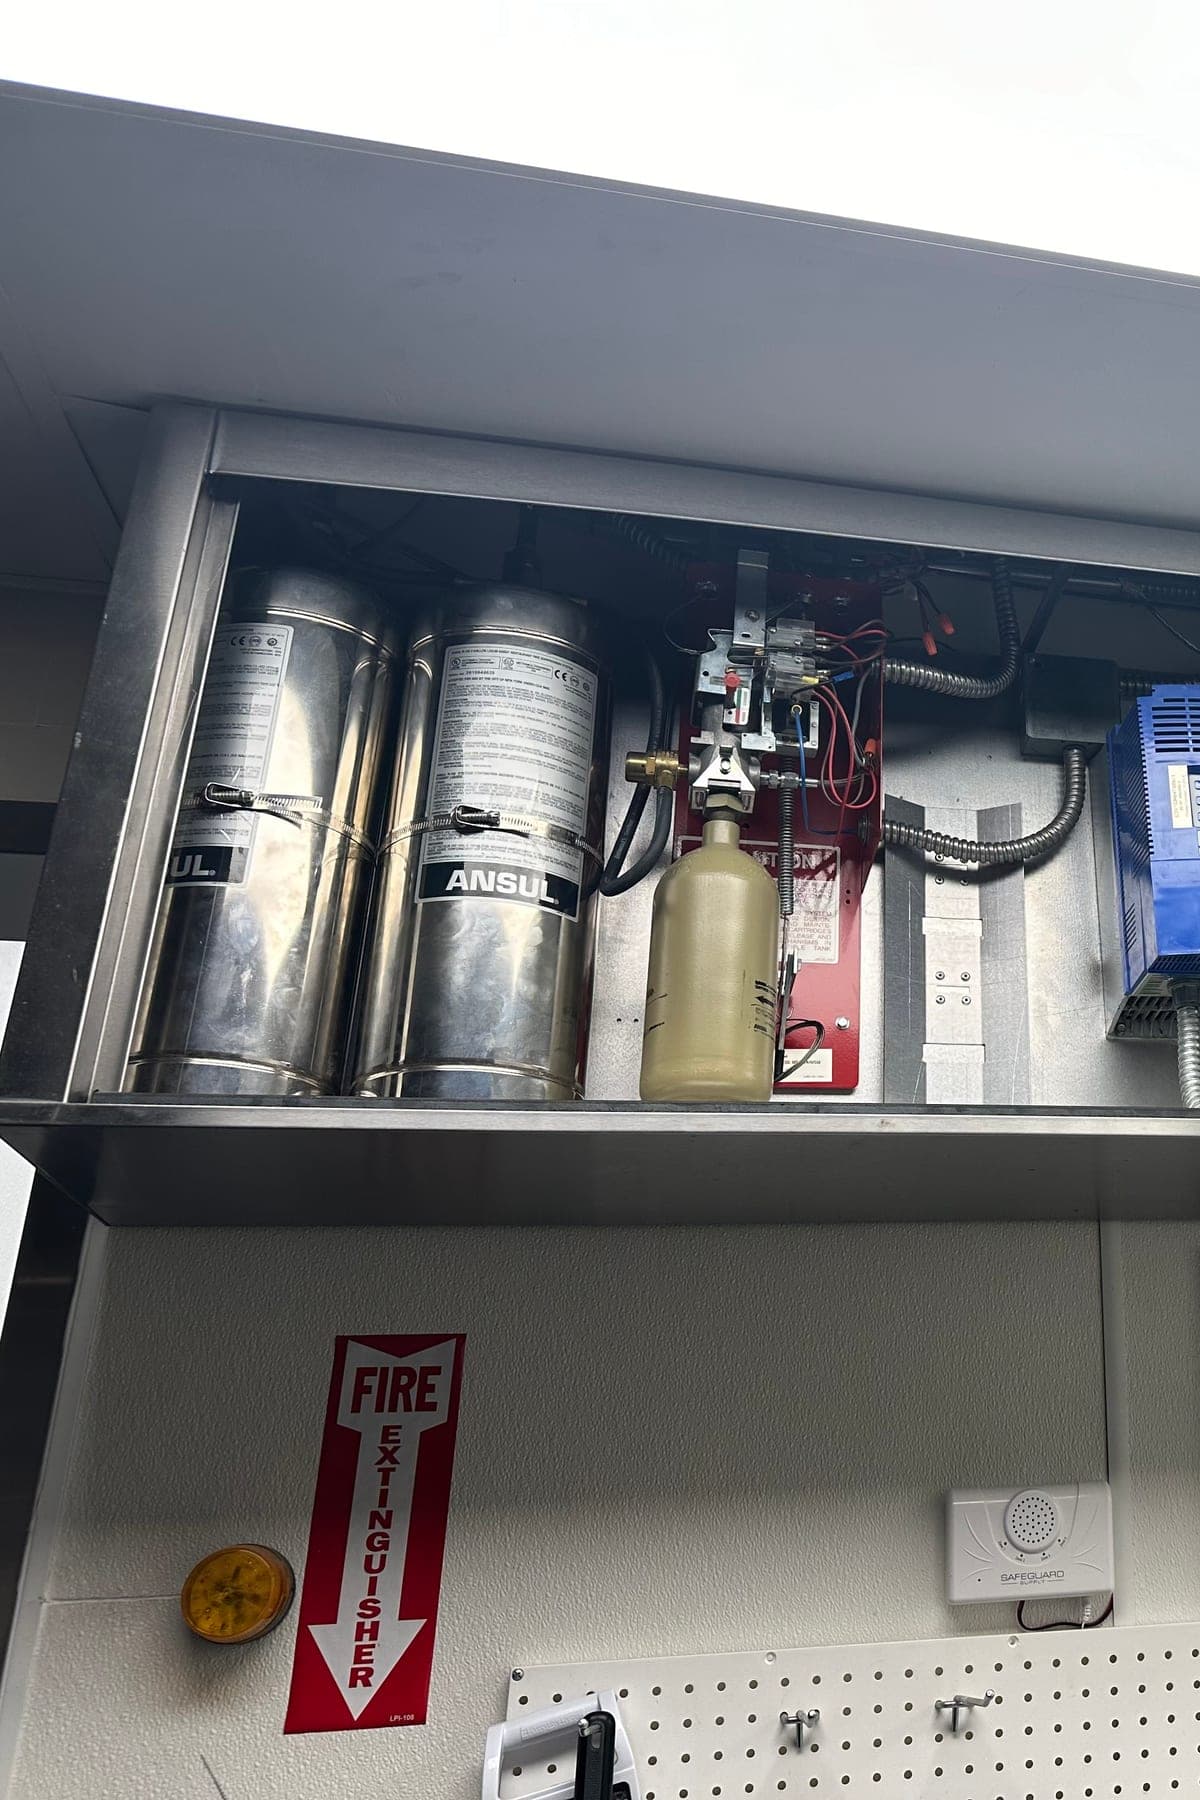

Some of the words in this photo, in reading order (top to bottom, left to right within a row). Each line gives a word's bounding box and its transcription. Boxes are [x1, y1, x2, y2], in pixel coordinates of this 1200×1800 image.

[446, 869, 560, 905] ANSUL
[350, 1366, 442, 1413] FIRE
[348, 1425, 402, 1688] EXTINGUISHER
[1001, 1570, 1064, 1582] SAFEGUARD
